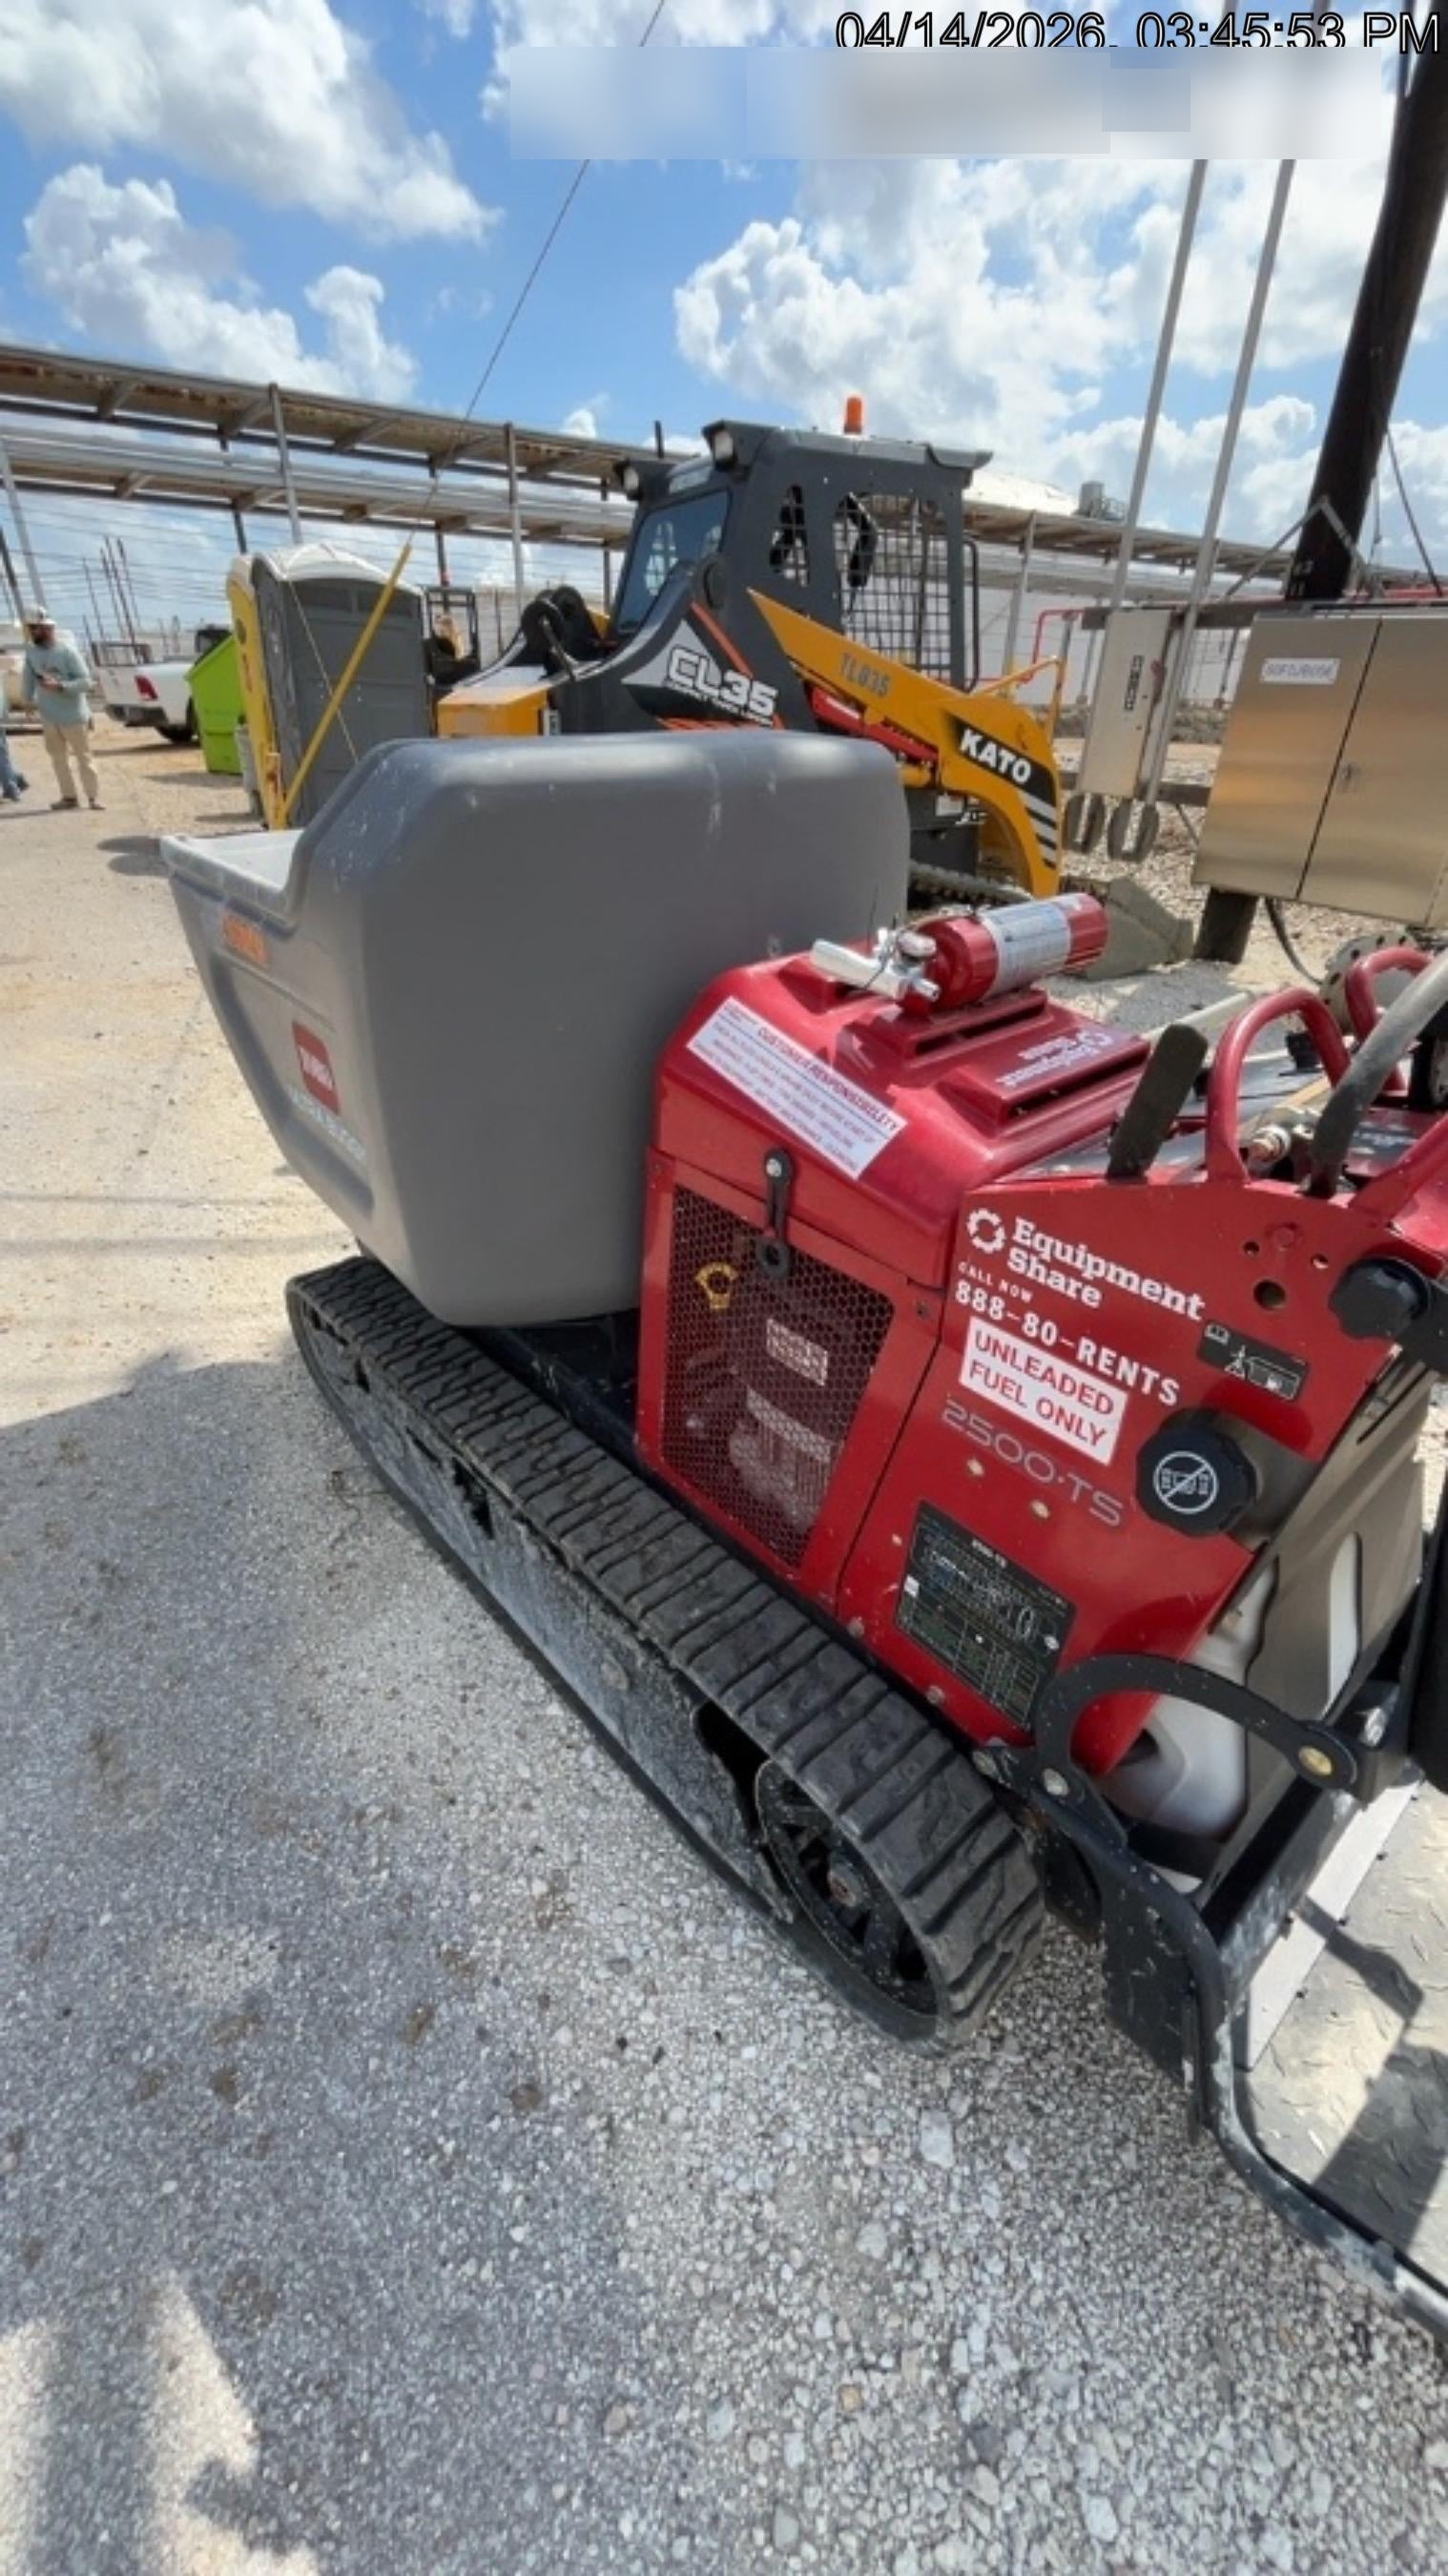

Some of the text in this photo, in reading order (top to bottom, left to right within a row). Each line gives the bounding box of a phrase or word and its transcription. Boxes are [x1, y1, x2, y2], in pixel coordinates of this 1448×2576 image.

[668, 645, 778, 717] CL35
[960, 728, 1032, 784] KATO
[808, 1061, 898, 1132] RESPONSIBILITY
[958, 1261, 1034, 1303] CALL NOW
[1006, 1246, 1103, 1308] Share
[1011, 1215, 1206, 1320] Equipment
[955, 1279, 1180, 1406] 888-80-RENTS
[975, 1329, 1114, 1415] UNLEADED
[969, 1359, 1107, 1447] FUEL ONLY
